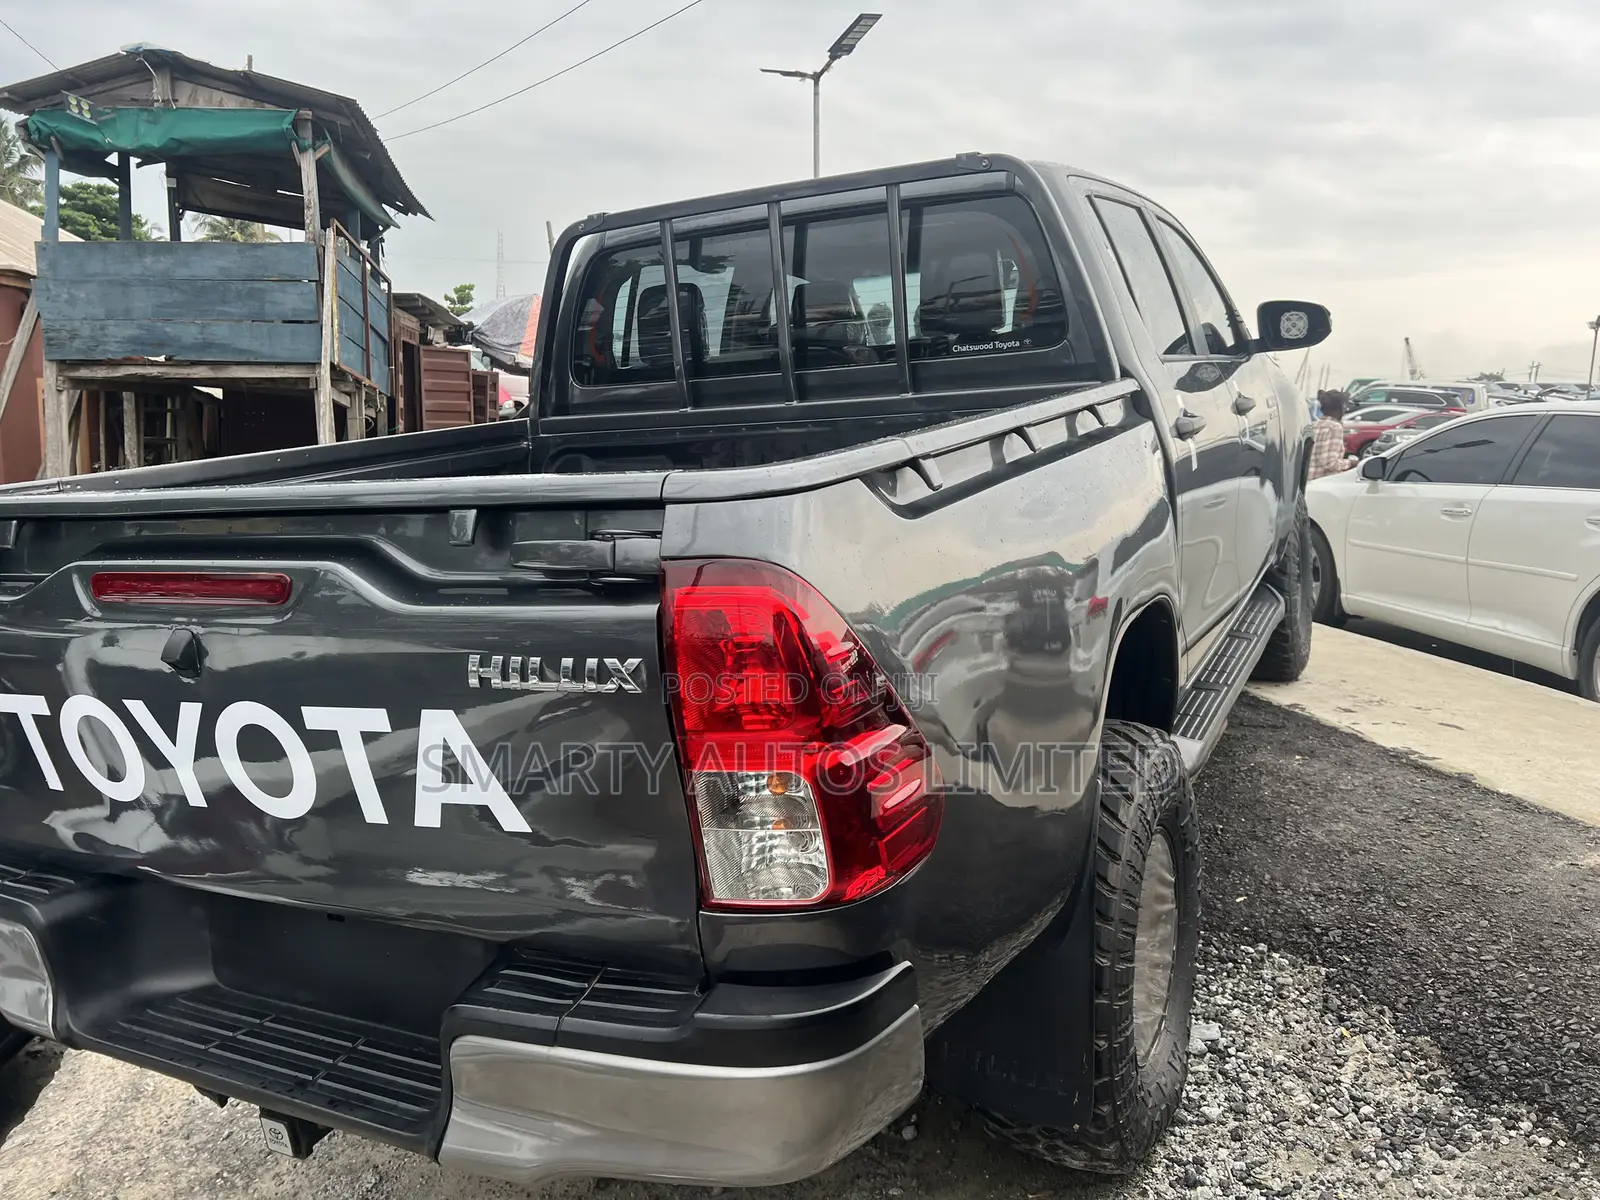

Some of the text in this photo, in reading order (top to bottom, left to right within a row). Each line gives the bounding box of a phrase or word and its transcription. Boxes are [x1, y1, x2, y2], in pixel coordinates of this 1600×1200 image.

[952, 340, 1020, 352] Chatswood Toyota
[468, 654, 643, 694] HILUX
[0, 693, 533, 833] TOYOTA
